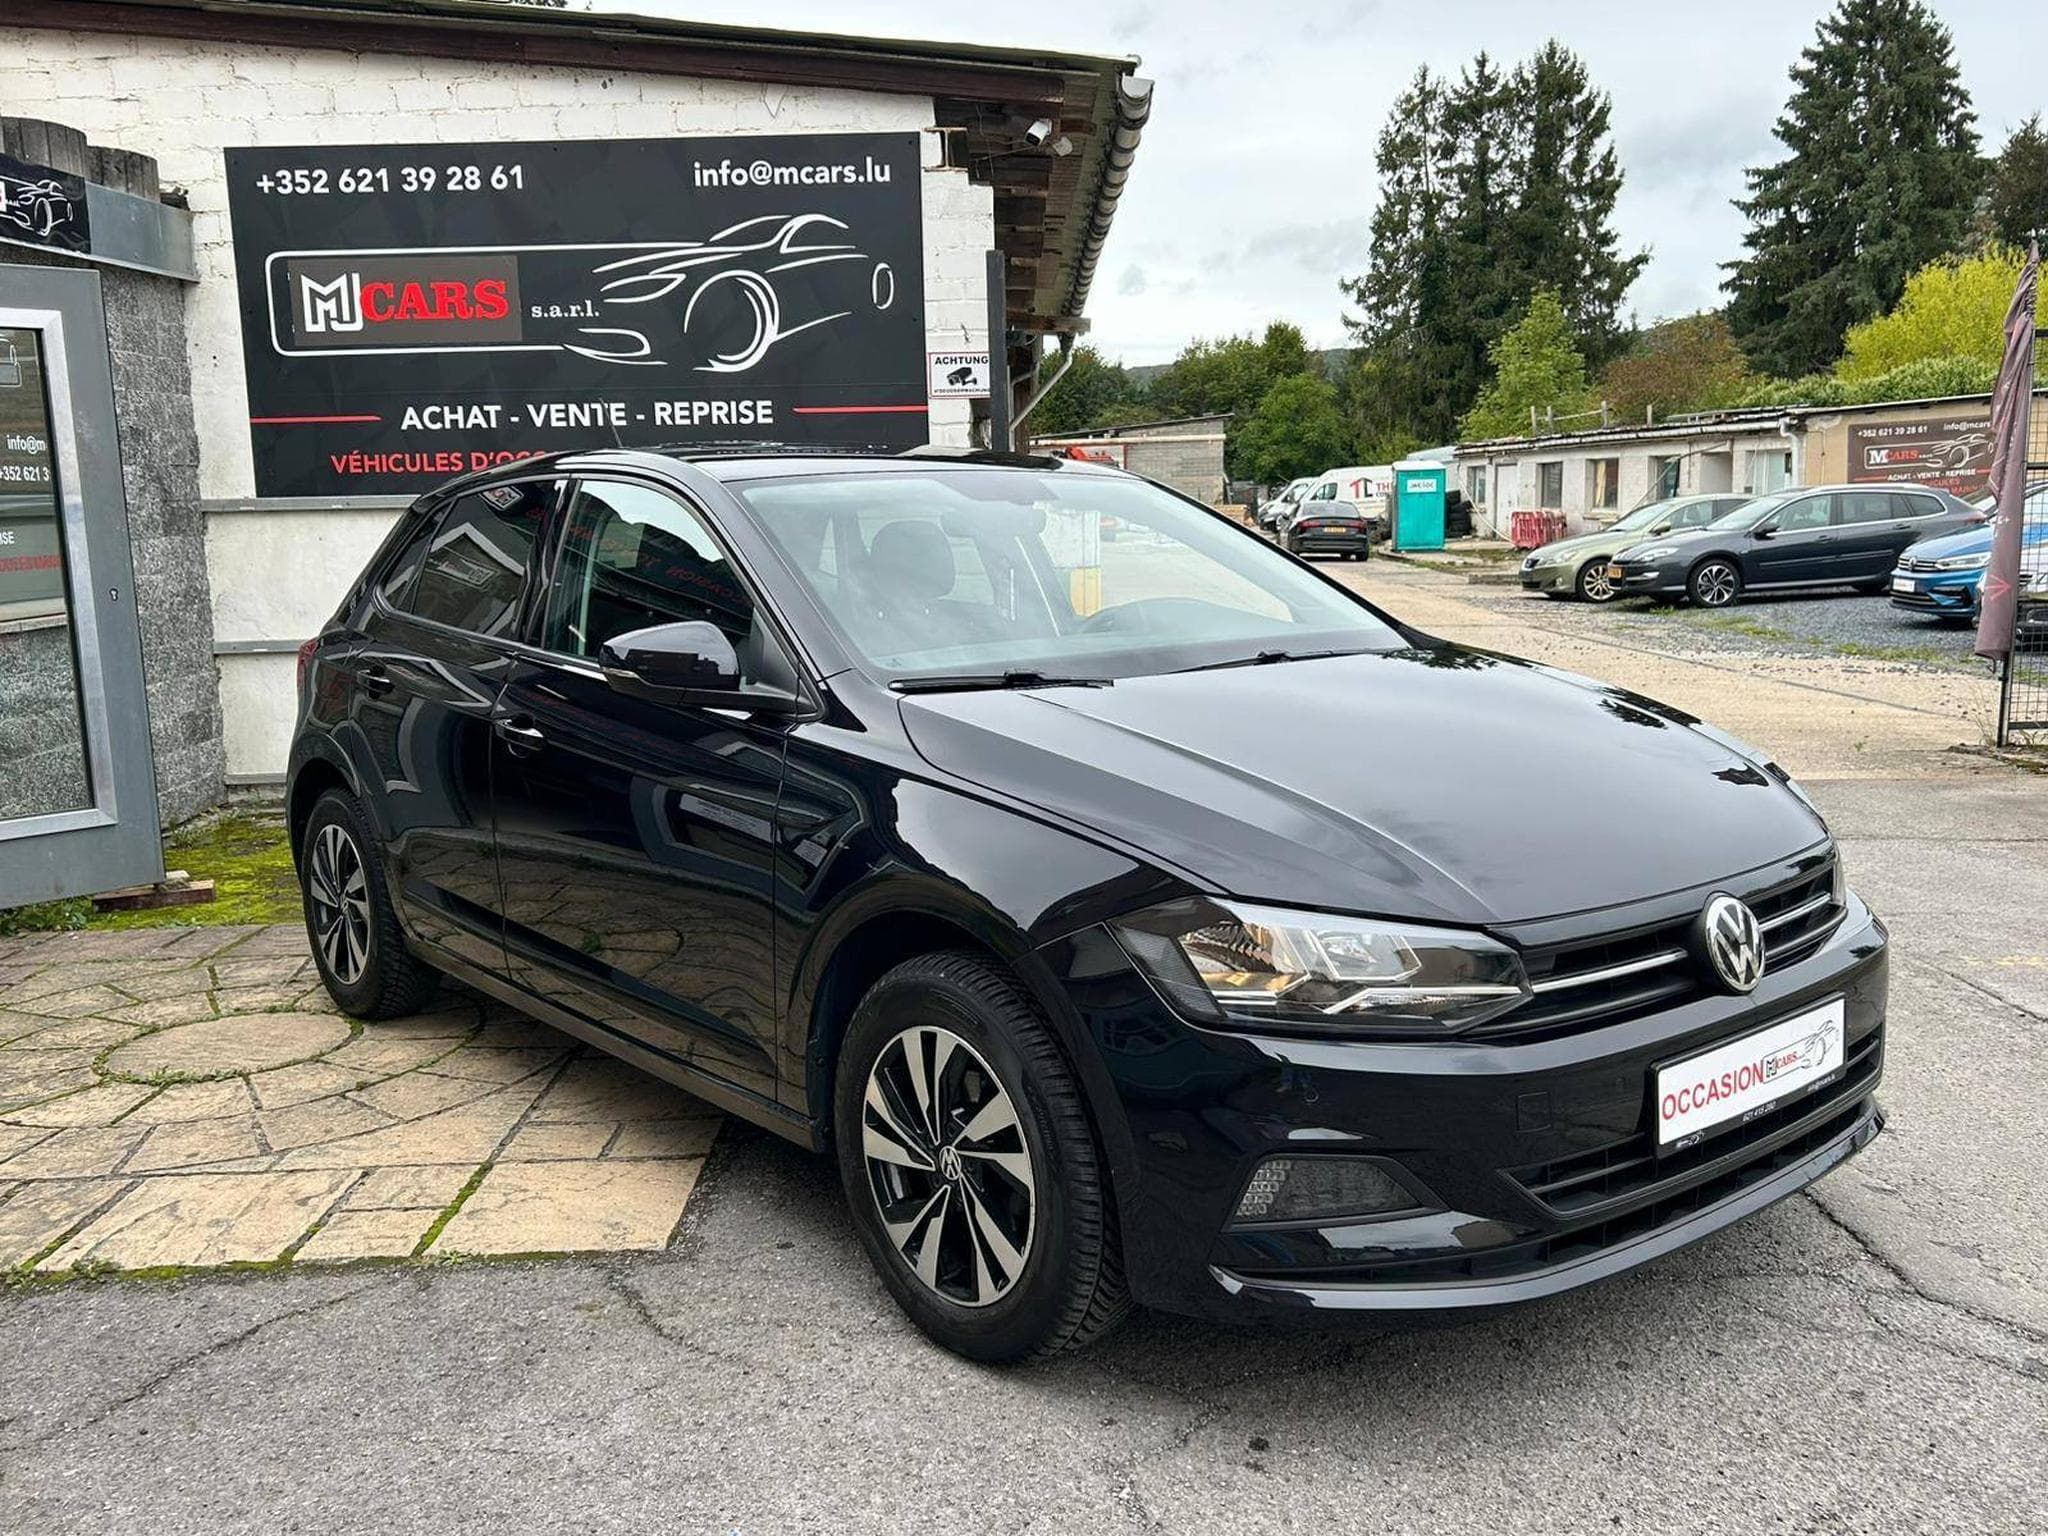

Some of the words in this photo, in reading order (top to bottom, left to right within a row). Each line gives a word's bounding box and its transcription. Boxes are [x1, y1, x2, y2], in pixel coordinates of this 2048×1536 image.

[256, 169, 330, 195] +352
[338, 168, 389, 193] 621
[401, 166, 436, 192] 39
[446, 165, 481, 191] 28
[490, 164, 523, 190] 61
[693, 156, 891, 187] info@mcars.lu
[531, 300, 600, 318] s.a.r.l.
[935, 355, 989, 365] ACHTUNG
[401, 405, 502, 430] ACHAT
[526, 403, 627, 428] VENTE
[654, 400, 774, 426] REPRISE
[23, 466, 40, 481] 621
[331, 450, 464, 475] VÉHICULES
[1662, 1059, 1764, 1120] OCCASION
